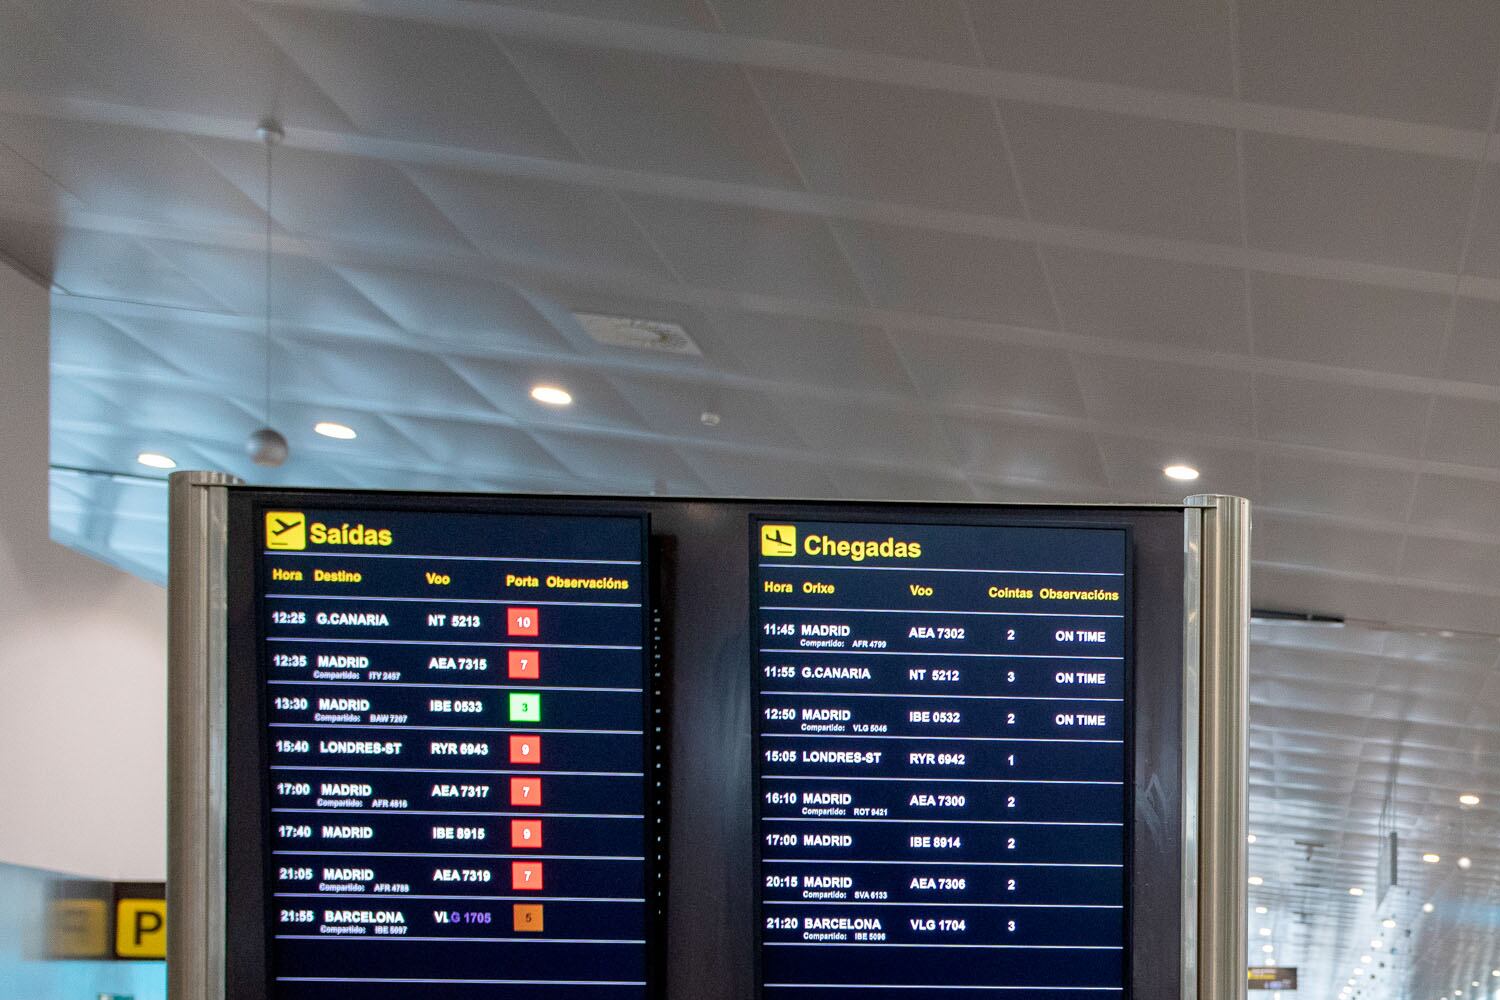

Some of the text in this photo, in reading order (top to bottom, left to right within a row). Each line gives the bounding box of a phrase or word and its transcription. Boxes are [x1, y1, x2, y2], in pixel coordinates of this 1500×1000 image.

[309, 523, 393, 546] Saídas
[803, 535, 922, 562] Chegadas
[273, 569, 629, 590] Hora Destino Voo Porta Observacións
[765, 582, 793, 593] Hora
[803, 582, 835, 594] Orixe
[910, 585, 934, 597] Voo
[1040, 588, 1120, 601] Observacións
[272, 613, 531, 628] 12:25 G.CANARIA NT 5213 10
[764, 625, 1107, 642] 11:45 MADRID AEA 7302 2 ON TIME
[800, 640, 845, 649] Compartido:
[851, 640, 869, 648] AFR
[274, 656, 528, 671] 12:35 MADRID AEA 7315 7
[313, 671, 360, 681] Compartido:
[765, 667, 1107, 685] 11:55 G.CANARIA NT 5212 3 ON TIME
[275, 699, 529, 713] 13:30 MADRID IBE 0533 3
[315, 714, 361, 723] Compartido:
[765, 709, 1107, 726] 12:50 MADRID IBE 0532 2 ON TIME
[801, 724, 846, 733] Compartido:
[852, 724, 870, 732] VLG
[277, 742, 530, 756] 15:40 LONDRES-ST RYR 6943 9
[765, 752, 1015, 766] 15:05 LONDRES-ST RYR 6942 1
[278, 784, 530, 798] 17:00 MADRID AEA 7317 7
[317, 799, 363, 808] Compartido:
[766, 794, 1016, 808] 16:10 MADRID AEA 7300 2
[802, 808, 847, 816] Compartido:
[853, 808, 871, 816] ROT
[279, 827, 531, 840] 17:40 MADRID IBE 8915 9
[766, 836, 1016, 850] 17:00 MADRID IBE 8914 2
[280, 869, 532, 882] 21:05 MADRID AEA 7319 7
[319, 884, 366, 893] Compartido:
[767, 877, 1016, 891] 20:15 MADRID AEA 7306 2
[803, 892, 847, 900] Compartido:
[853, 891, 871, 899] SVA
[281, 911, 532, 923] 21:55 BARCELONA VLG 1705 5
[134, 911, 163, 945] P
[320, 926, 367, 935] Compartido:
[767, 919, 1016, 932] 21:20 BARCELONA VLG 1704 3
[803, 933, 847, 941] Compartido:
